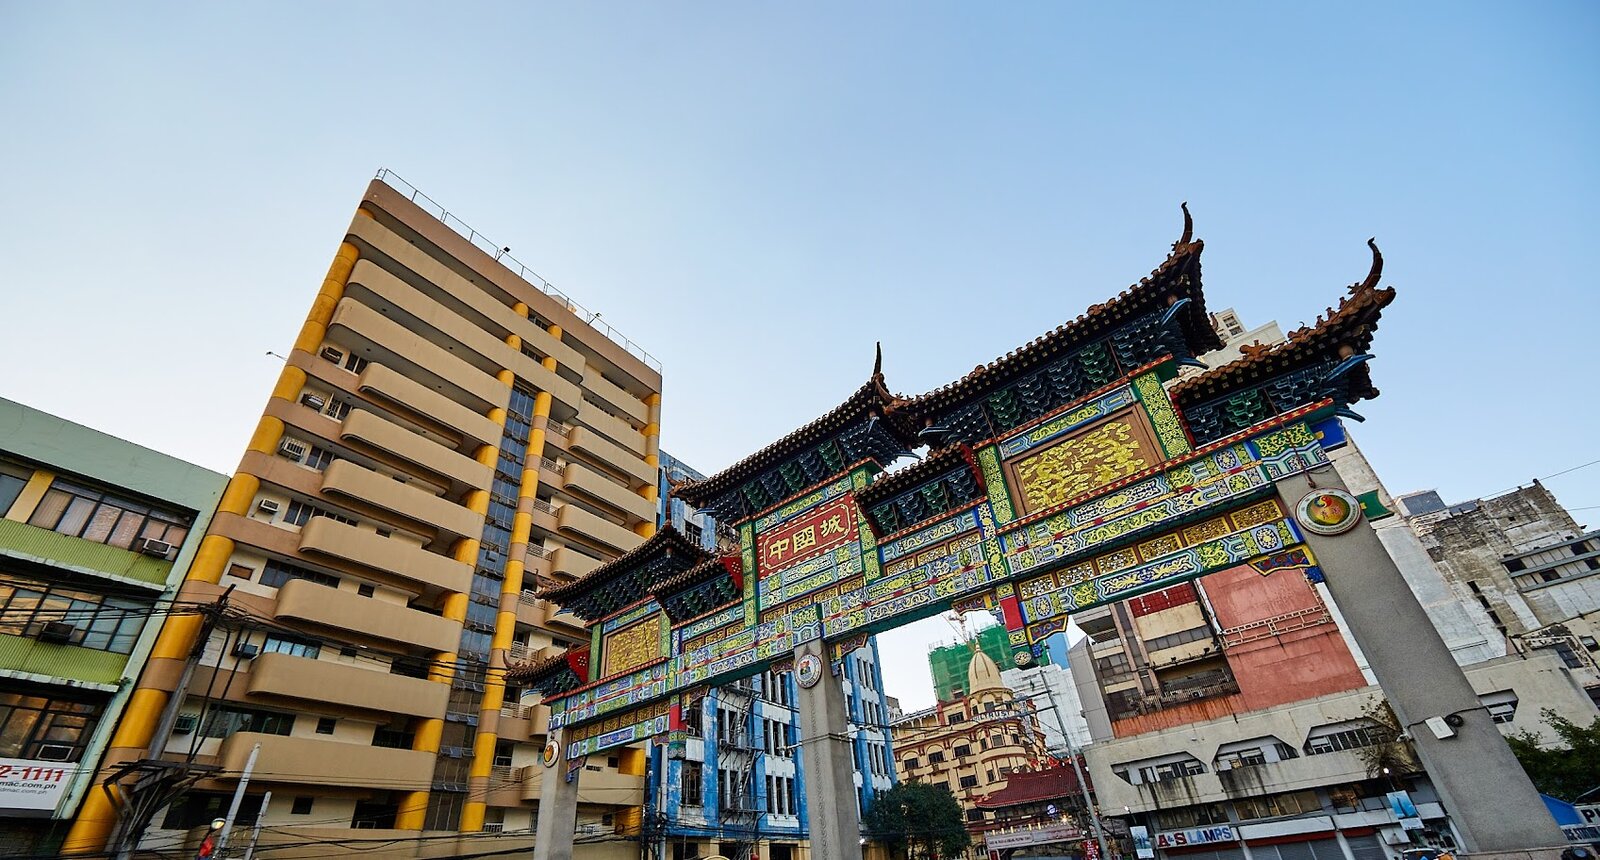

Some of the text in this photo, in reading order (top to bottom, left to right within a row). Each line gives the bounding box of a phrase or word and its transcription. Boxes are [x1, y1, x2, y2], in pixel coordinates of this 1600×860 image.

[769, 515, 846, 560] 中國城
[0, 765, 64, 782] 2-1111
[1158, 827, 1232, 848] A&S LAMPS
